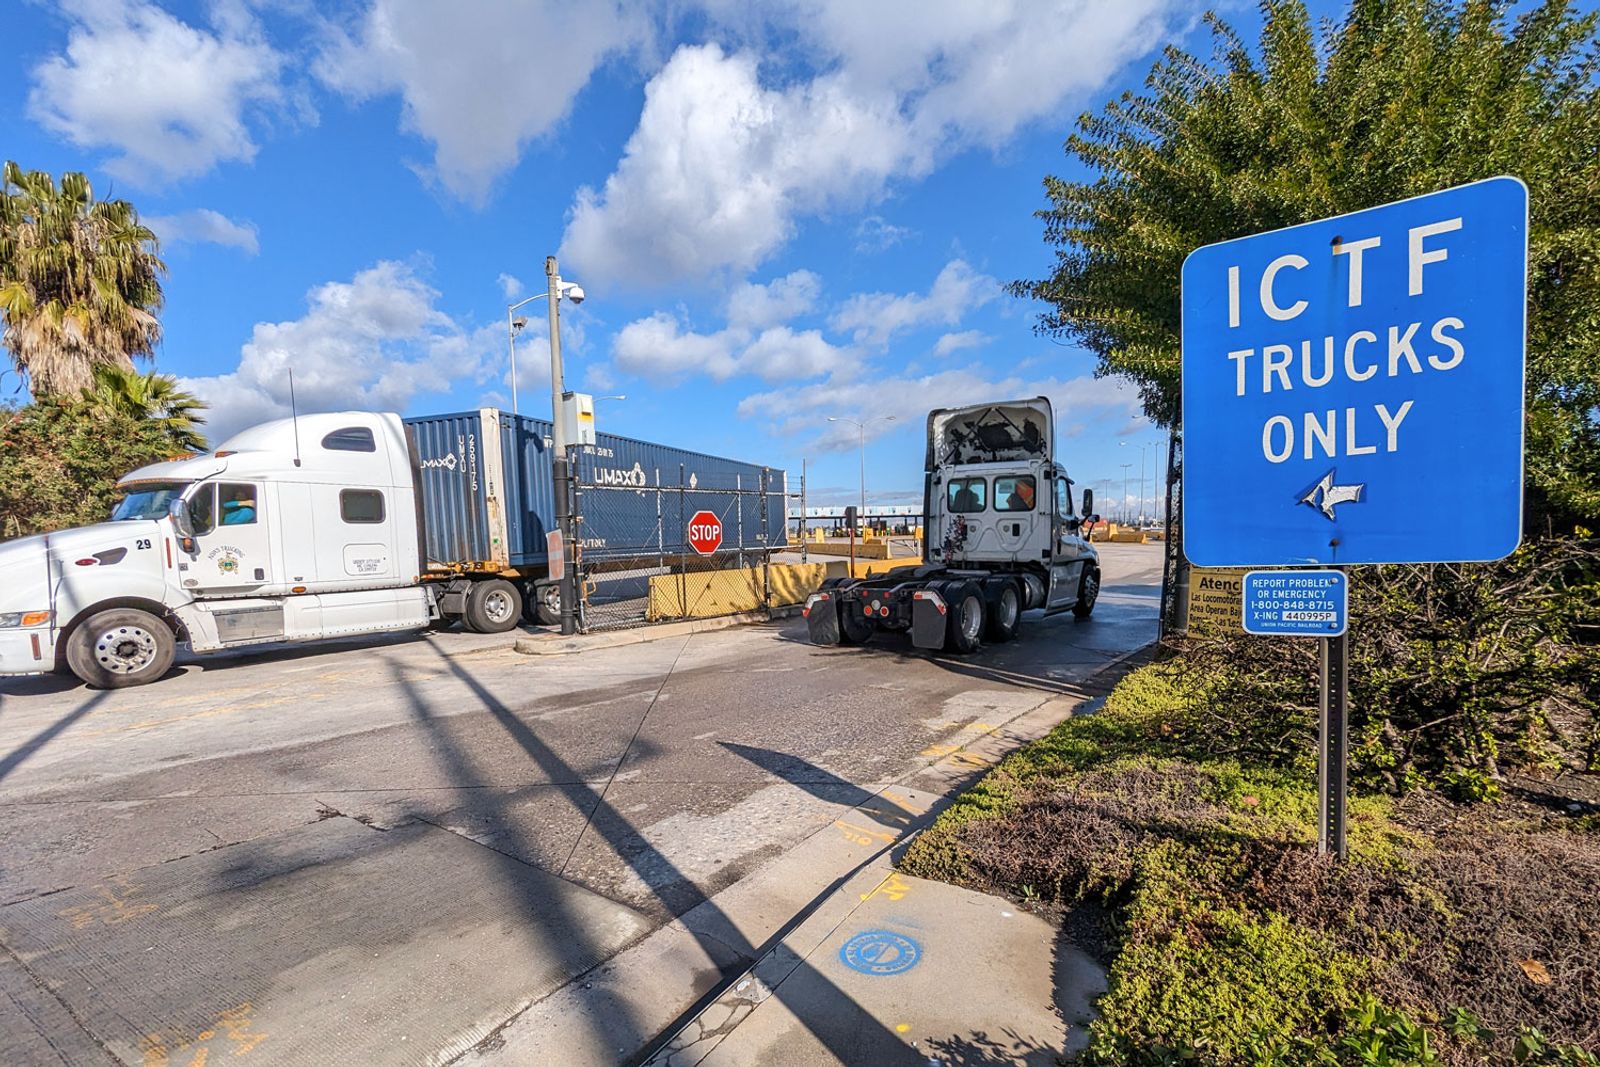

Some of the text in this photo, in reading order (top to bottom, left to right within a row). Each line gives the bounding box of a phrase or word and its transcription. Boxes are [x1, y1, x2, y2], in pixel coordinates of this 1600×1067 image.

[1228, 317, 1465, 396] TRUCKS
[1262, 400, 1414, 463] ONLY
[691, 524, 720, 541] STOP
[136, 538, 152, 550] 29
[1199, 576, 1242, 591] Atenc
[1252, 578, 1286, 588] REPORT
[1257, 590, 1327, 599] OR EMERGENCY
[1251, 600, 1335, 610] 1-800-848-8715
[1253, 611, 1332, 621] X-ING 440995P
